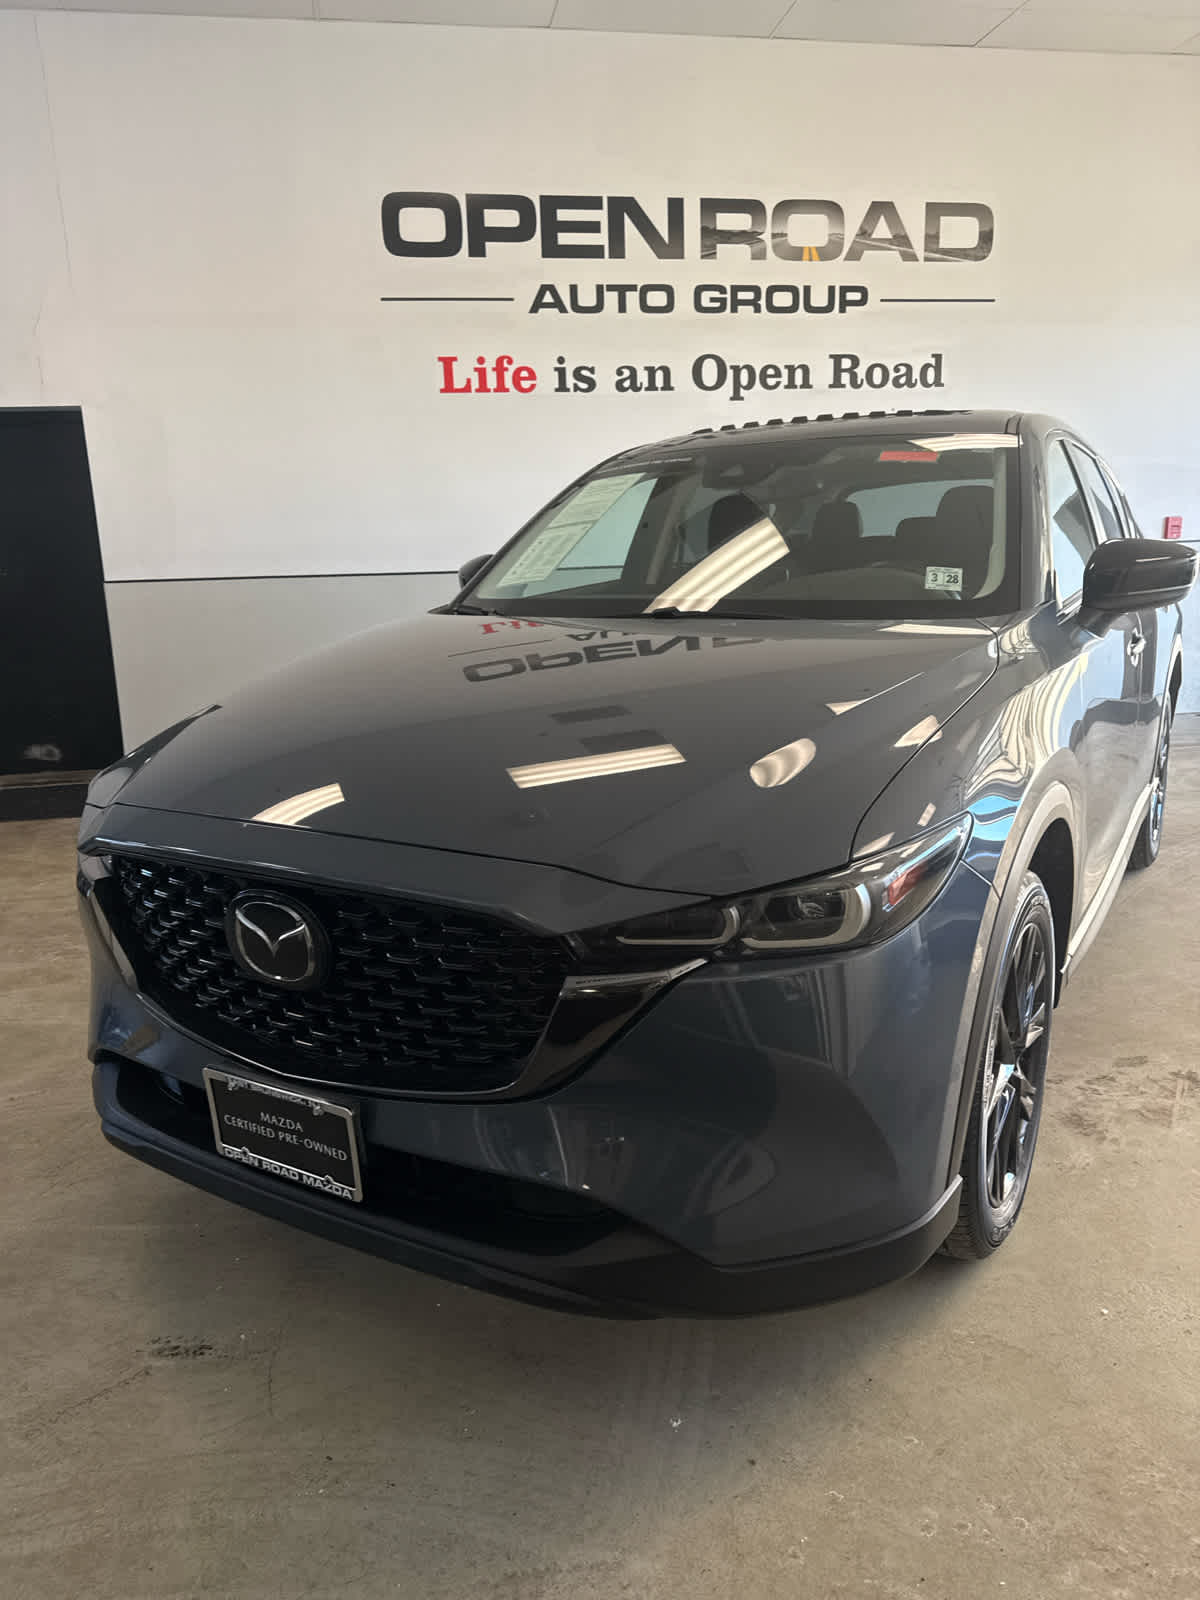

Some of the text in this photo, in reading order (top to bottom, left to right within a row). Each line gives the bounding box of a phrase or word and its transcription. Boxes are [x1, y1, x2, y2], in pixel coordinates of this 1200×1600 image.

[380, 191, 994, 263] OPEN ROAD
[528, 283, 869, 314] AUTO GROUP
[437, 353, 945, 402] Life is an Open Road
[931, 573, 959, 584] 3 28
[224, 1114, 348, 1161] CERTIFIED PRE-OWNED
[260, 1112, 304, 1133] MAZDA
[224, 1148, 353, 1200] OPEN ROAD MAZDA
